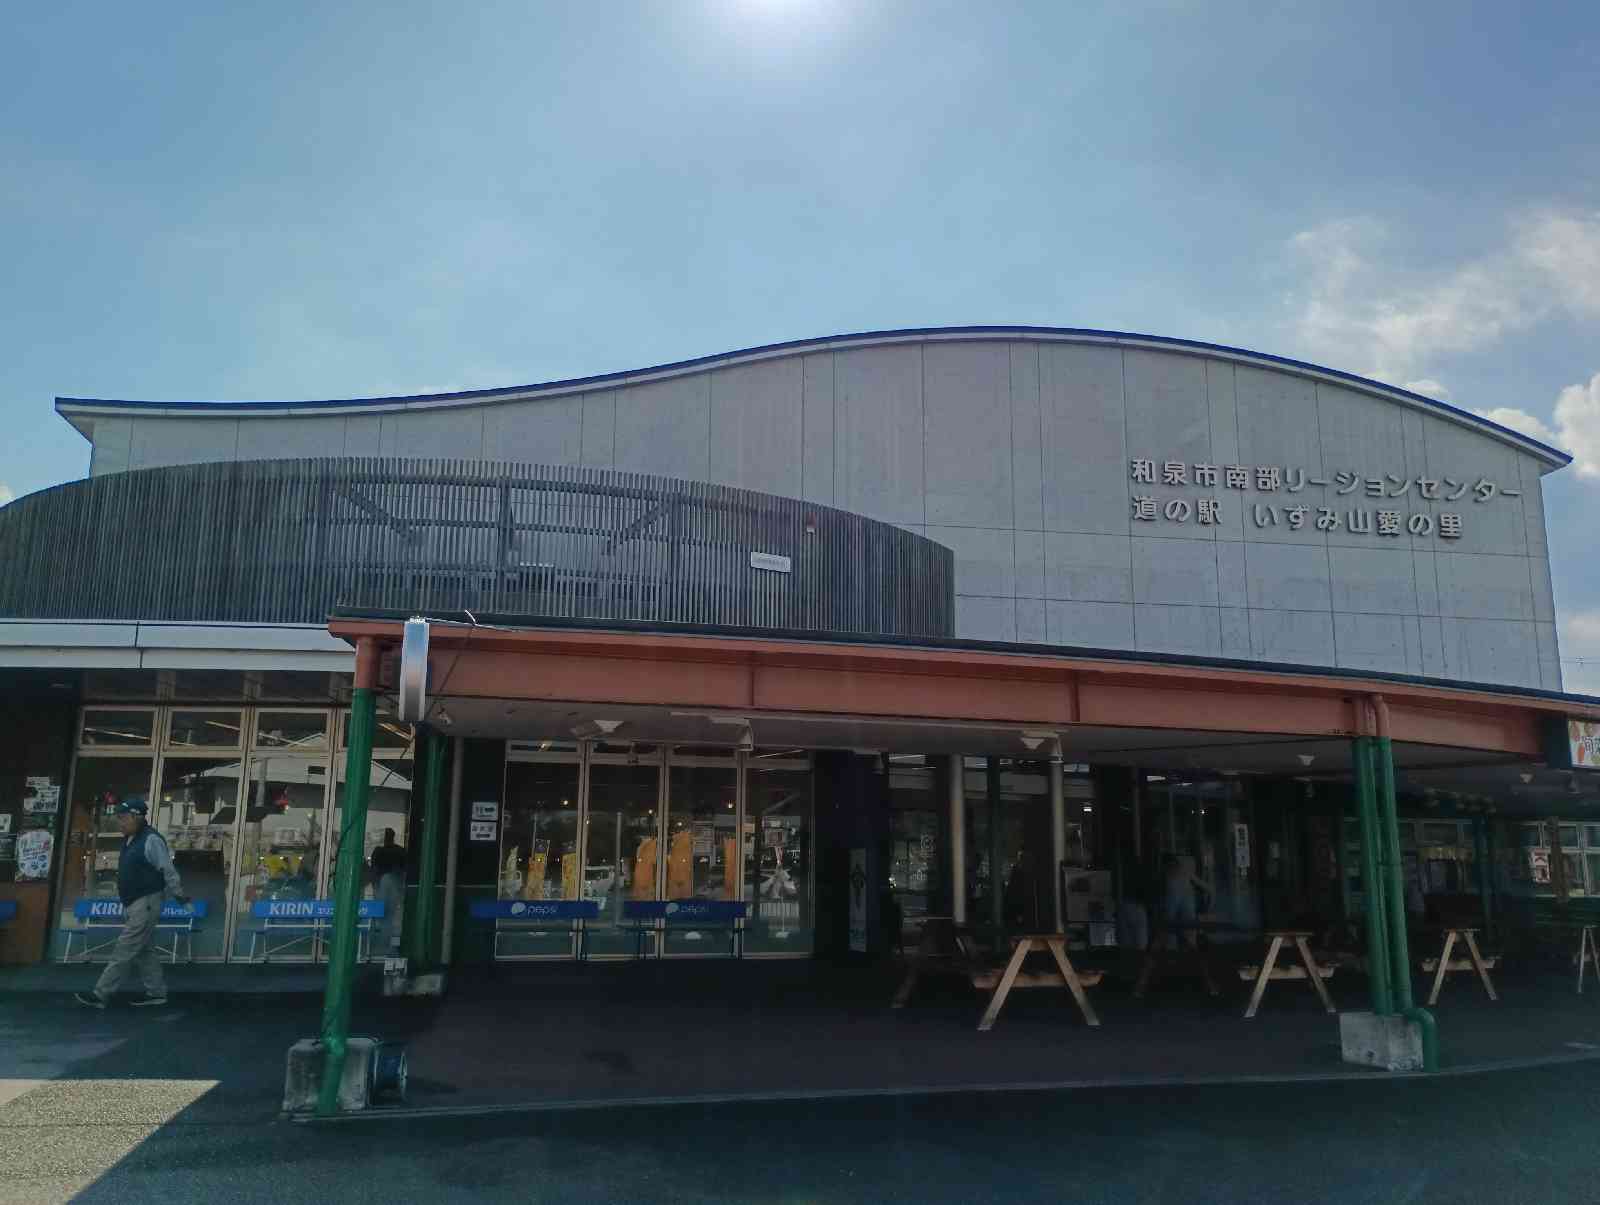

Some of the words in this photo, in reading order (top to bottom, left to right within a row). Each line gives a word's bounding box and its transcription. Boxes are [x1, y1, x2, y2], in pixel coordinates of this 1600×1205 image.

[1132, 458, 1522, 502] 和泉市南部リージョンセンター
[1132, 496, 1222, 525] 道の駅
[1253, 503, 1462, 539] いずみ山愛の里
[90, 902, 126, 916] KIRI
[269, 902, 314, 916] KIRIN
